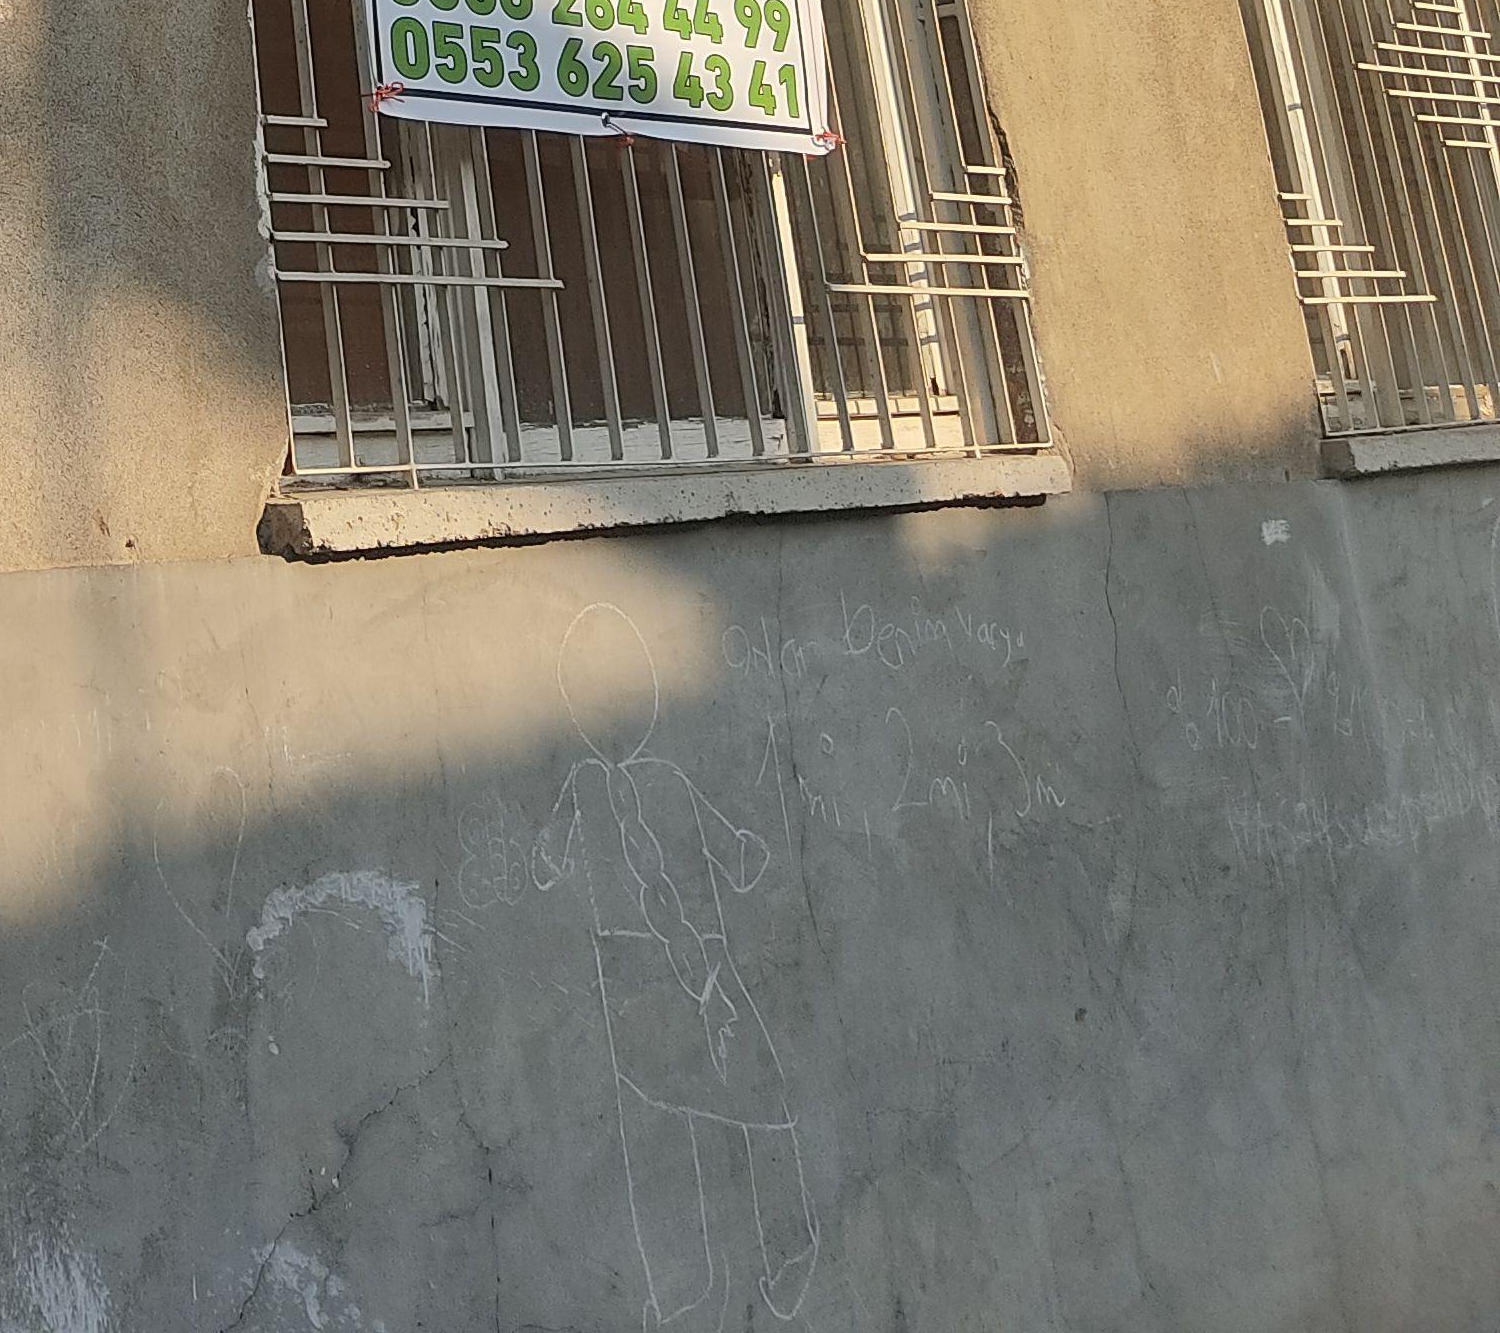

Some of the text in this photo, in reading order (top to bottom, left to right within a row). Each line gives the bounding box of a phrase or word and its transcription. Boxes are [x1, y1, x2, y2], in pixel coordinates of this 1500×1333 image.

[390, 16, 800, 118] 0553 625 43 41
